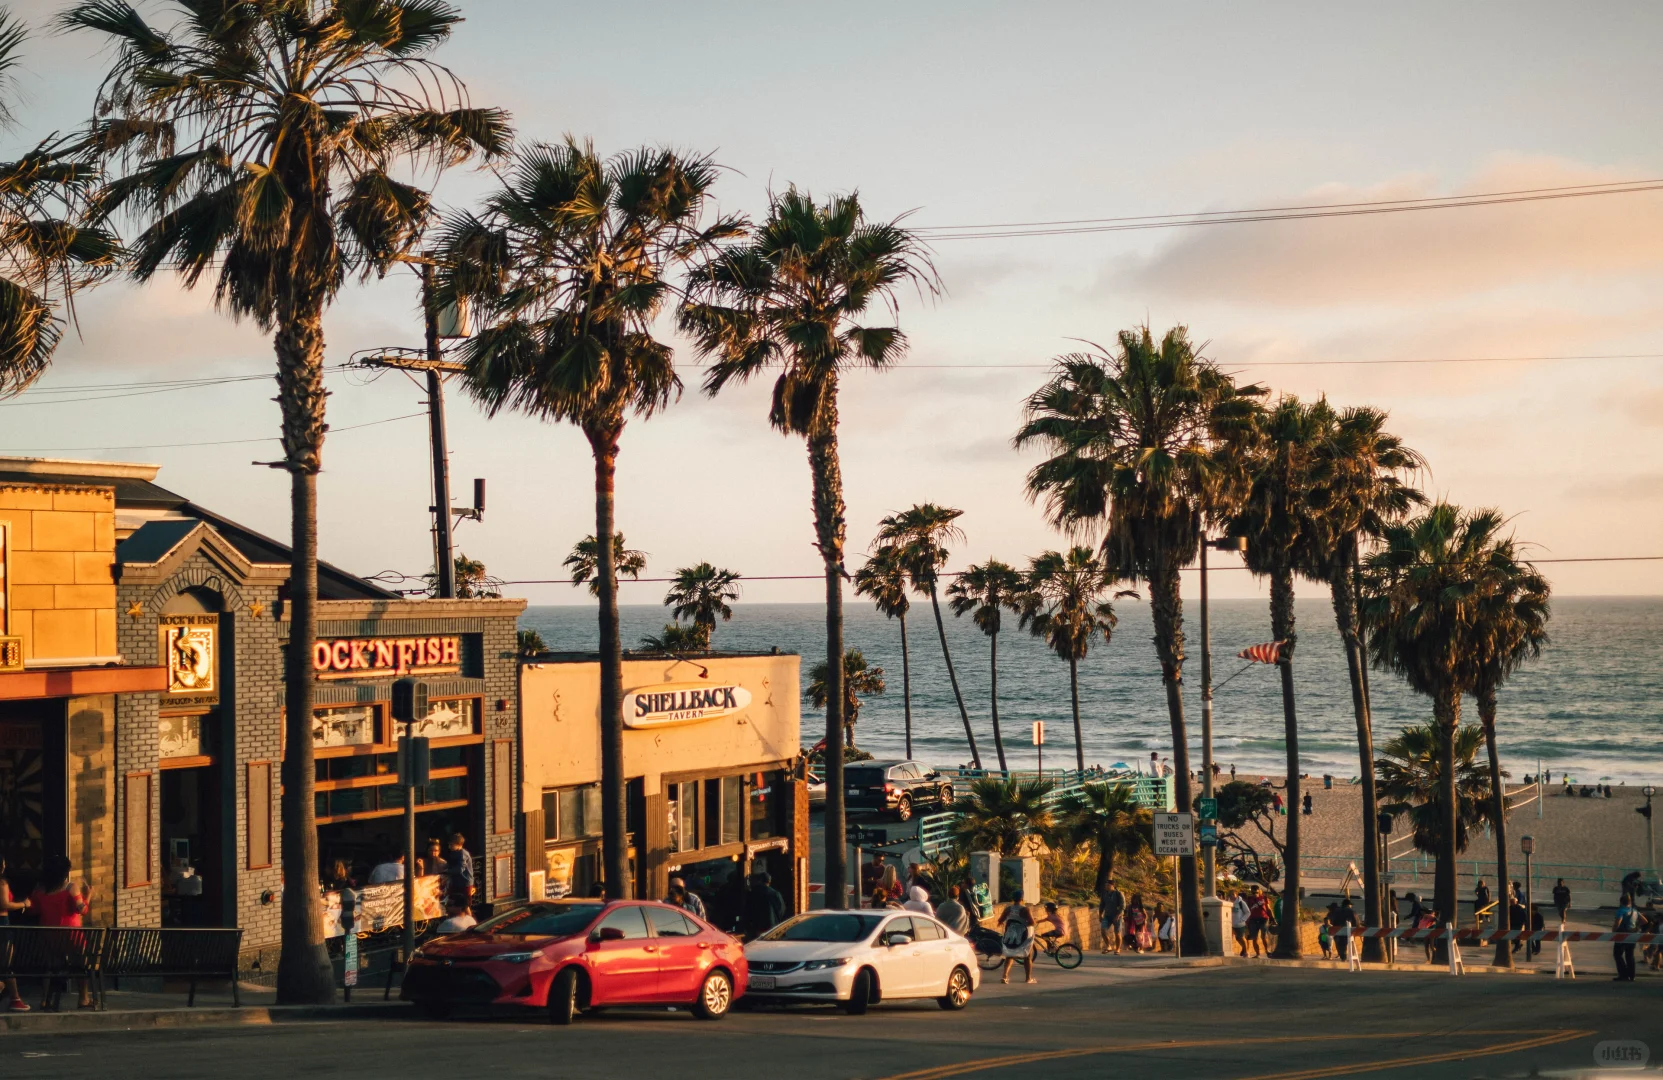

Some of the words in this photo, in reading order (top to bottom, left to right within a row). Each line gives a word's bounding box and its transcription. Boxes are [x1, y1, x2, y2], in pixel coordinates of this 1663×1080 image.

[197, 615, 218, 625] FISH
[312, 640, 395, 670] OCK'N
[395, 636, 460, 675] FISH
[635, 686, 738, 717] SHELLBACK
[668, 709, 704, 721] TAVERN
